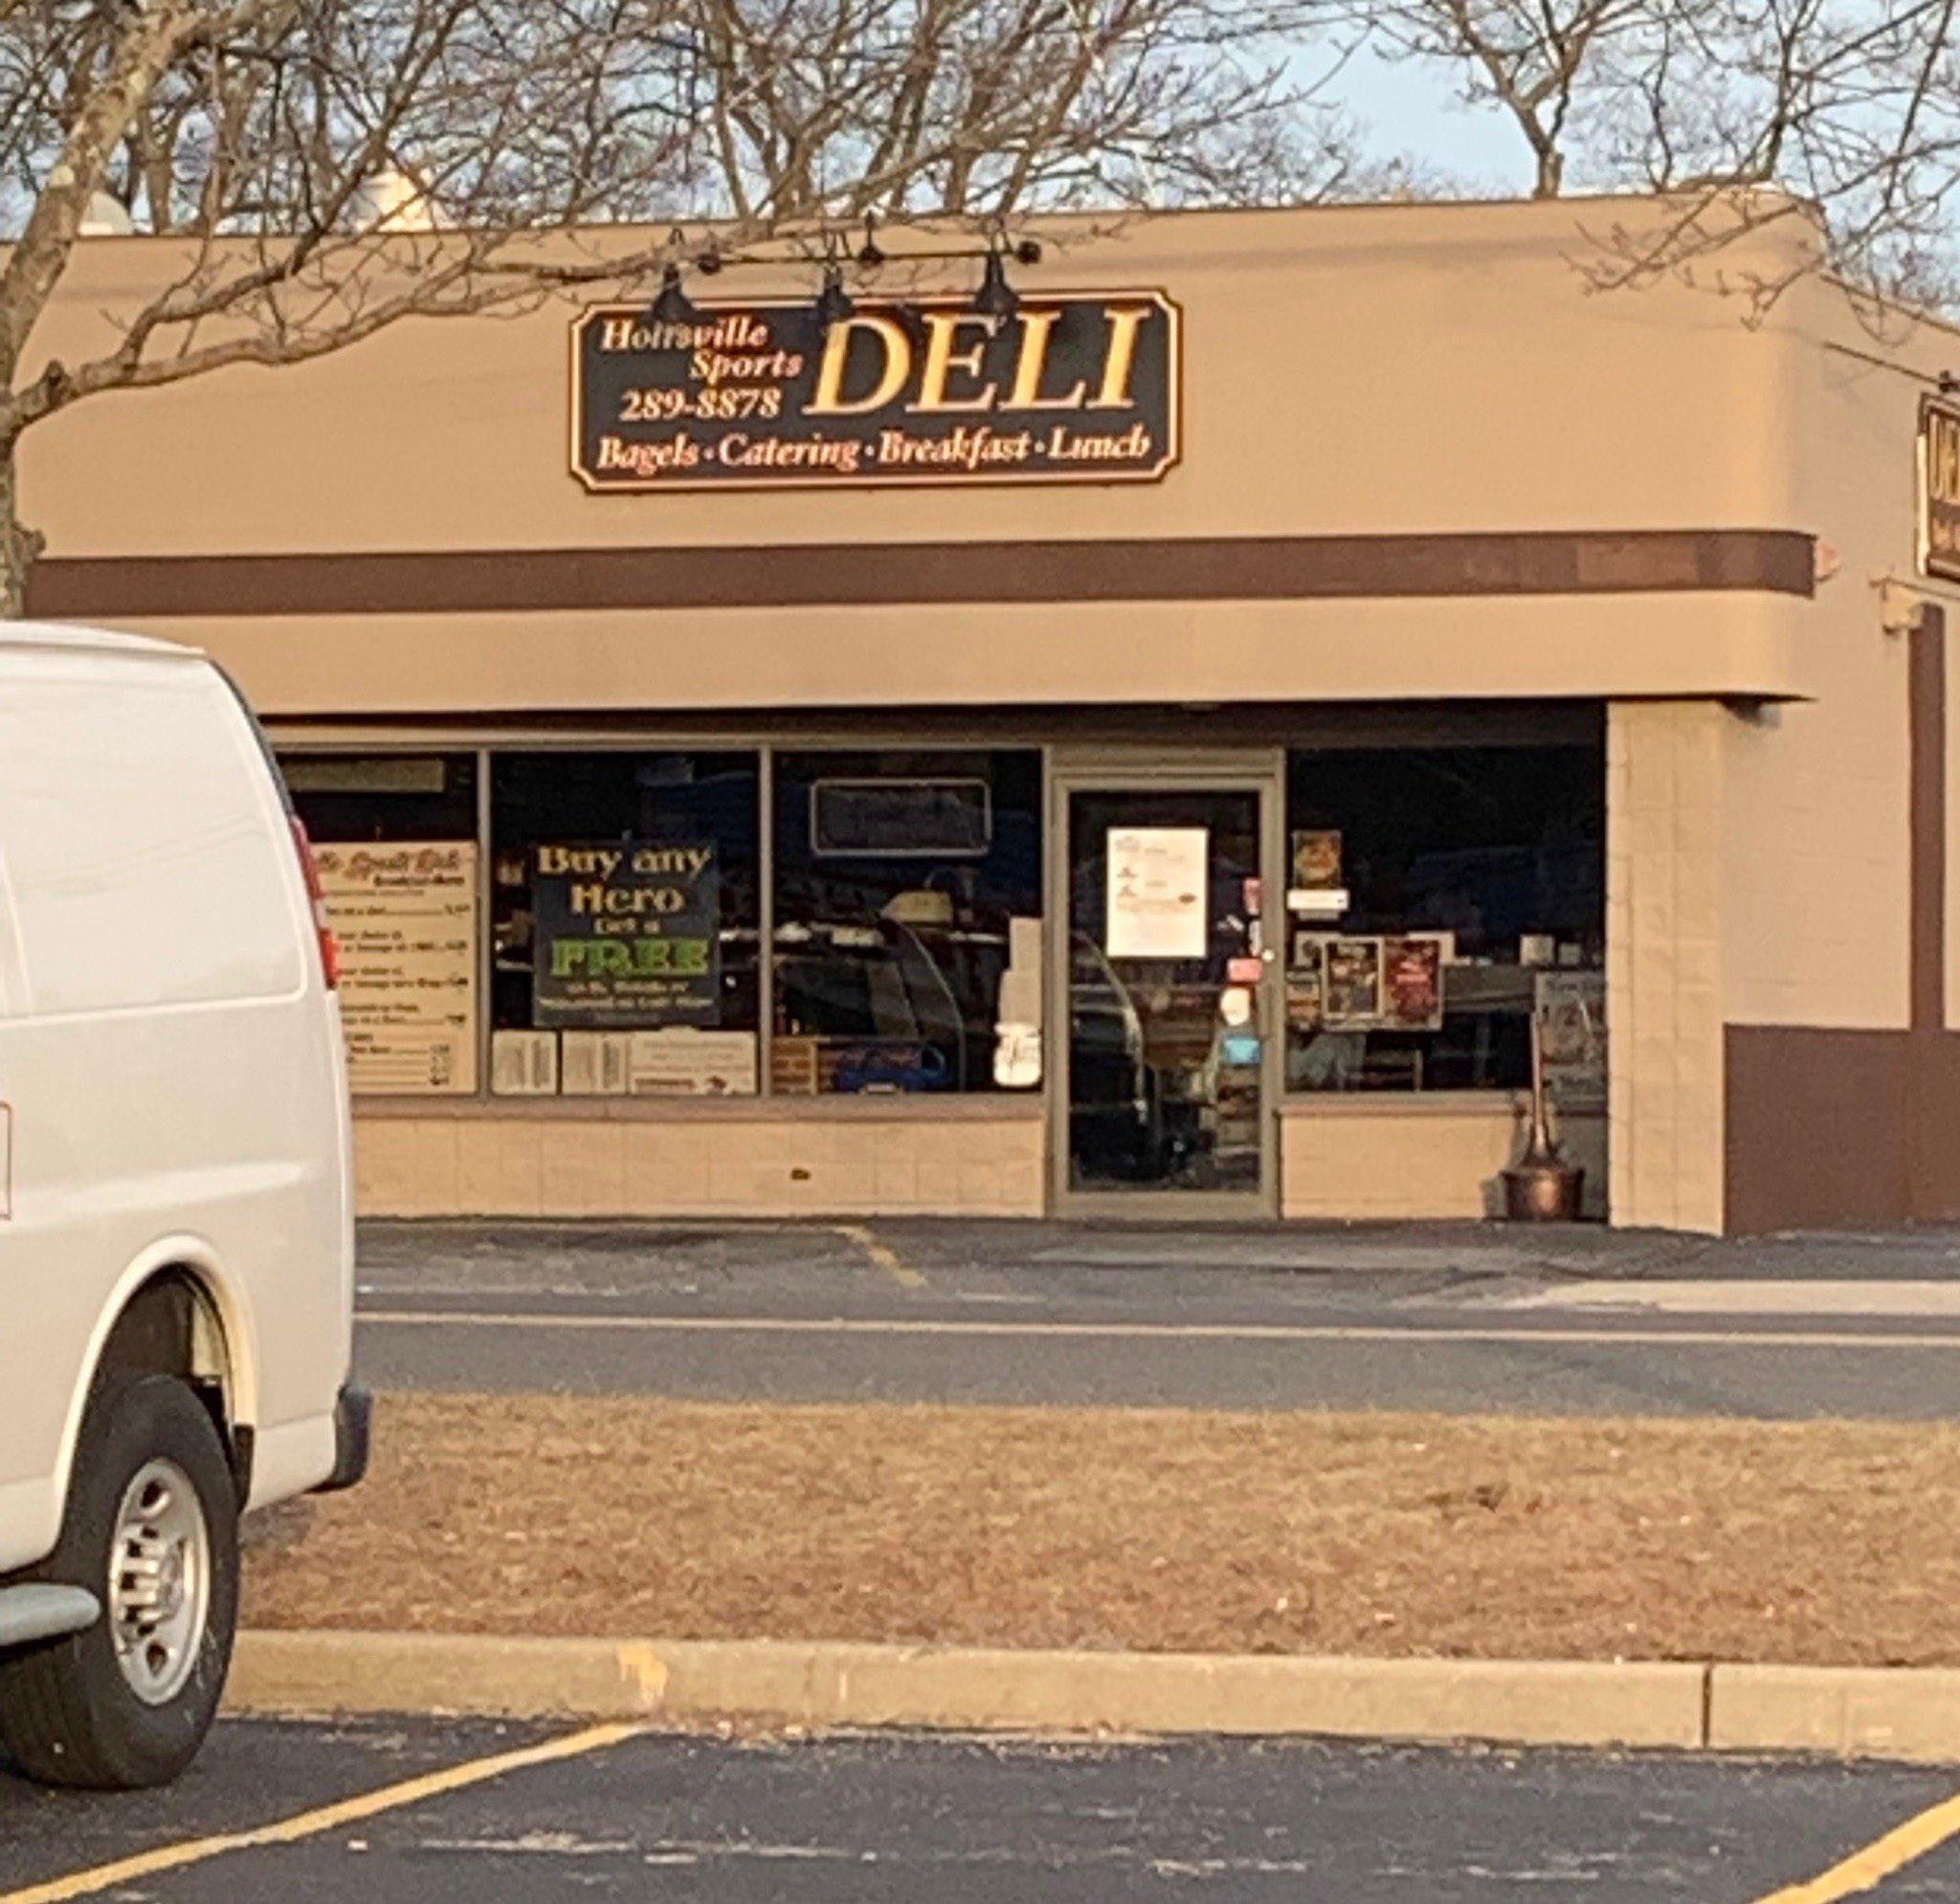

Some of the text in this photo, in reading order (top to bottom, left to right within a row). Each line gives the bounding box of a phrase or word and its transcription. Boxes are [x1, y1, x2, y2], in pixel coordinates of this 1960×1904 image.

[688, 347, 804, 386] Sports
[801, 309, 1151, 414] DELI
[619, 387, 782, 422] 289-8878
[596, 421, 1151, 476] Bagels Catering Breakfast Lunch
[537, 845, 712, 882] Buy any
[570, 883, 687, 915] Hero
[551, 939, 710, 977] FREE
